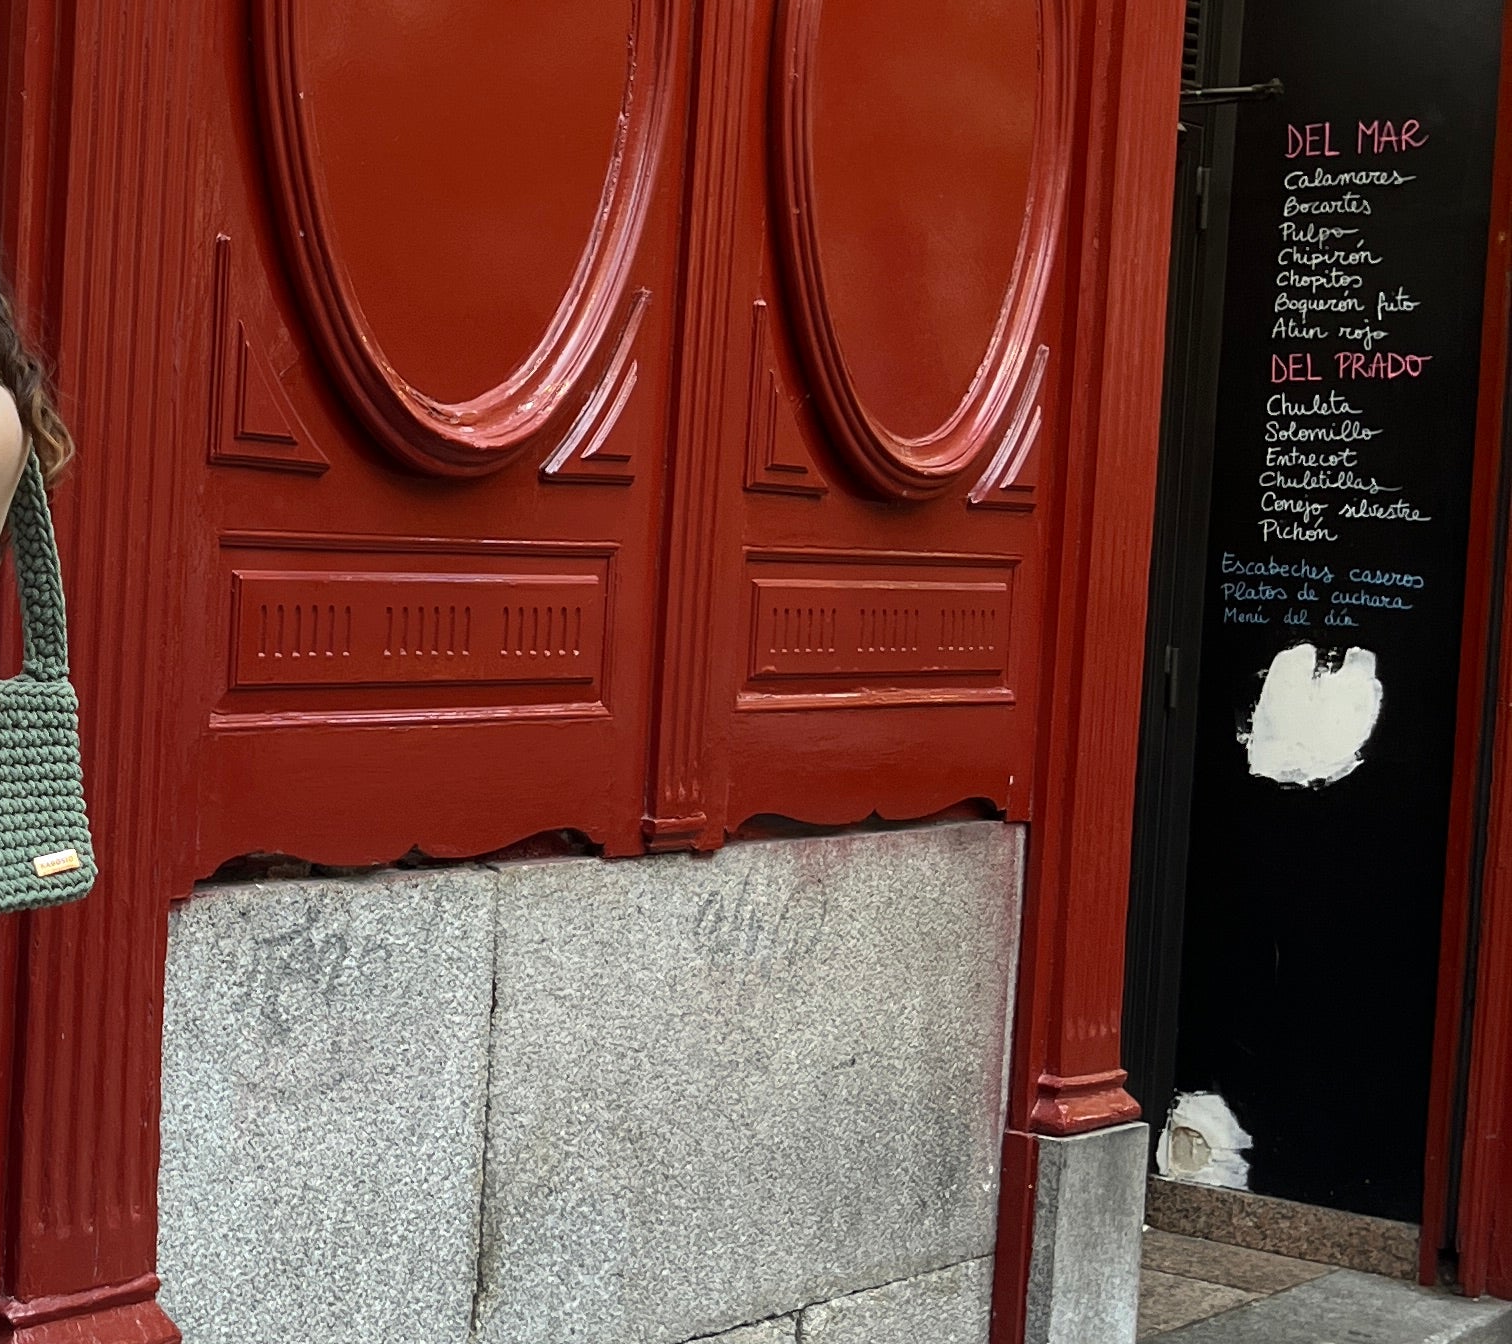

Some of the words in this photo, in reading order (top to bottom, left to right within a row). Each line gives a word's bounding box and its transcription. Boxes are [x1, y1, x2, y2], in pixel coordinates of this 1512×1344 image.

[1286, 122, 1339, 158] DEL
[1358, 120, 1428, 153] MAR
[1284, 168, 1416, 189] Calamares
[1284, 192, 1371, 217] Bocartes
[1279, 222, 1359, 249] Pulpo
[1278, 239, 1382, 270] Chipirón
[1277, 267, 1362, 293] Chopitos
[1275, 290, 1364, 324] Boquerón
[1272, 318, 1328, 338] Atún
[1339, 318, 1388, 350] rojo
[1271, 353, 1322, 383] DEL
[1334, 352, 1432, 379] PRADO
[1267, 390, 1362, 415] Chuleta
[1265, 420, 1382, 441] Solomillo
[1267, 447, 1357, 466] Entrecot
[1259, 471, 1400, 493] Chuletillas
[1261, 492, 1328, 523] Conejo
[1339, 499, 1431, 521] silvestre
[1258, 517, 1337, 541] Pichón
[1222, 552, 1334, 583] Escabeches
[1350, 569, 1423, 588] caseros
[1224, 582, 1287, 600] Platos
[1298, 584, 1318, 600] de
[1332, 591, 1412, 609] cuchara
[1225, 606, 1268, 623] Menú
[1284, 610, 1308, 624] del
[1325, 610, 1357, 626] día
